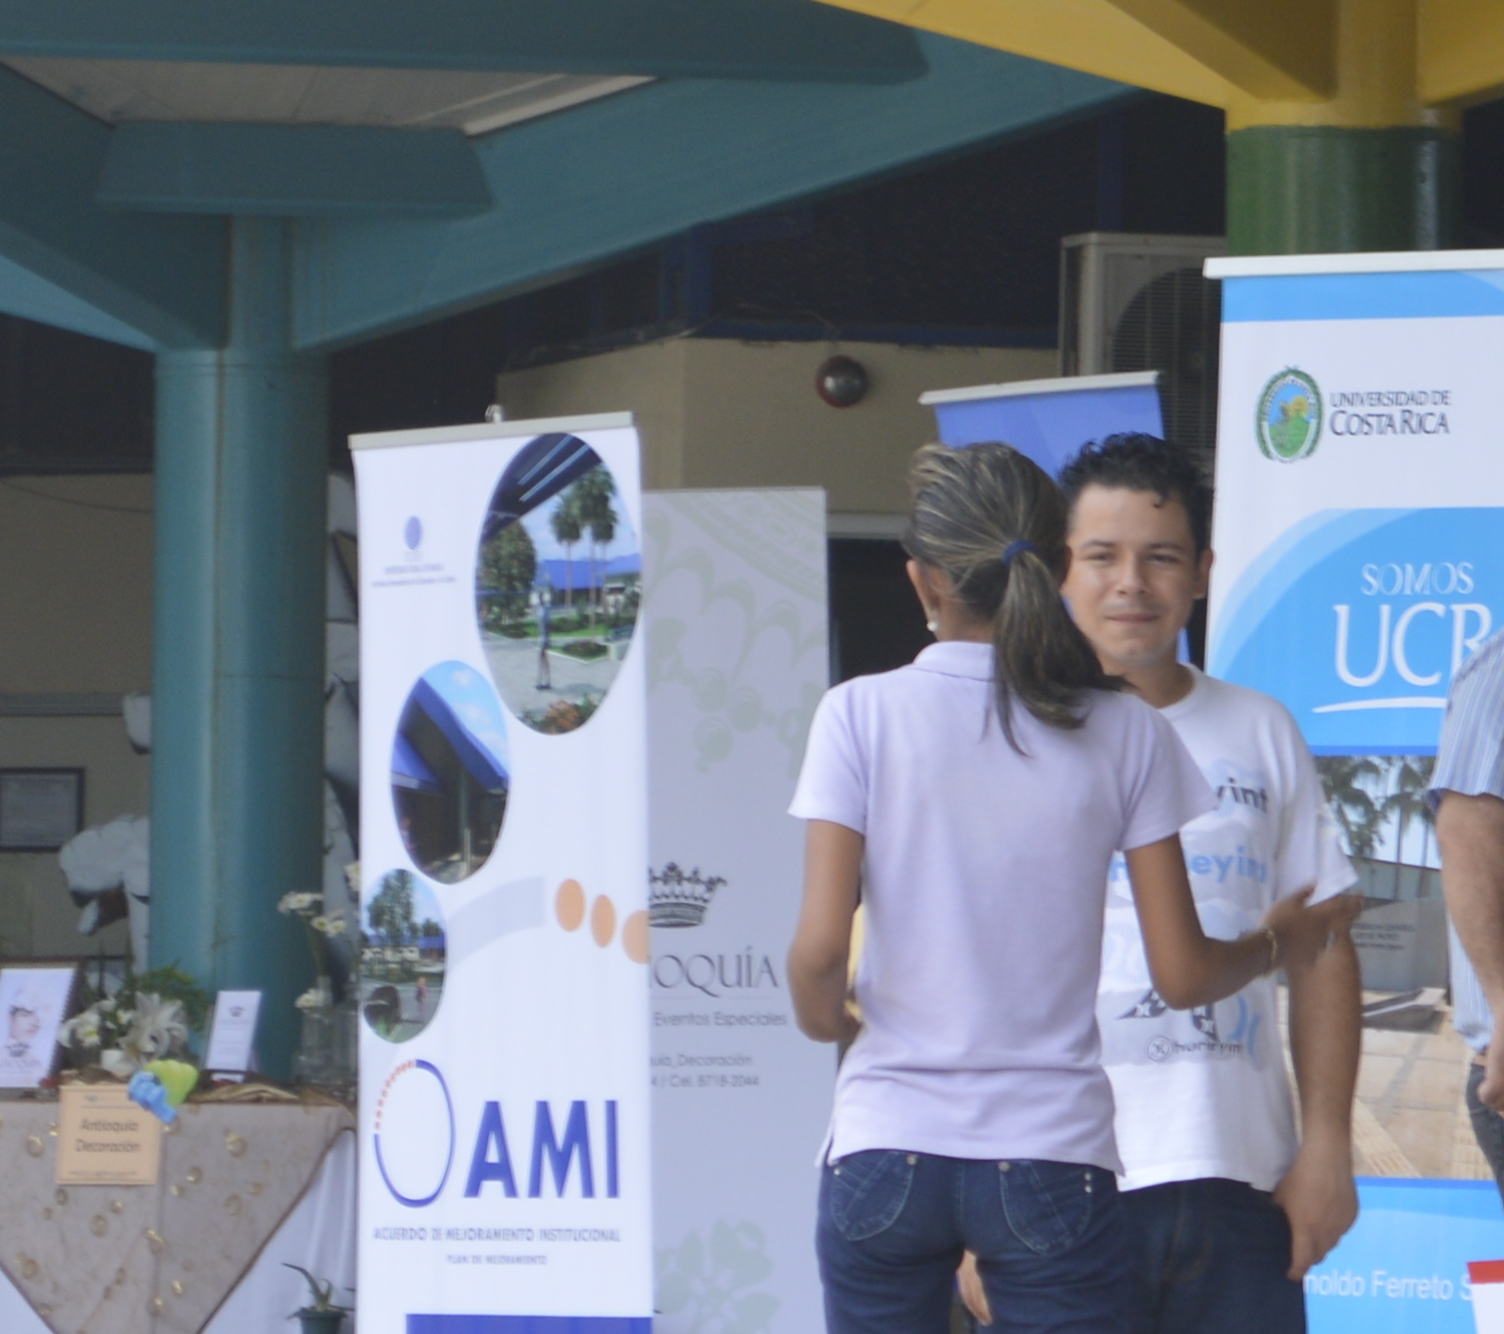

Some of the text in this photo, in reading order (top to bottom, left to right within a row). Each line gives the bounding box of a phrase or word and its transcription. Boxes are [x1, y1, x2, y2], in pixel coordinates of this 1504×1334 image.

[1330, 390, 1451, 408] UNIVERSIDAD DE
[1361, 562, 1475, 596] SOMOS
[1333, 601, 1492, 689] UCR
[648, 946, 779, 997] OQUÍA
[654, 1012, 787, 1028] Eventos Especiales
[463, 1099, 620, 1199] AMI
[374, 1227, 621, 1243] ACUERDO DE MEJORAMIENTO INSTITUCIONAL
[1305, 1269, 1472, 1301] noldo Ferreto S
